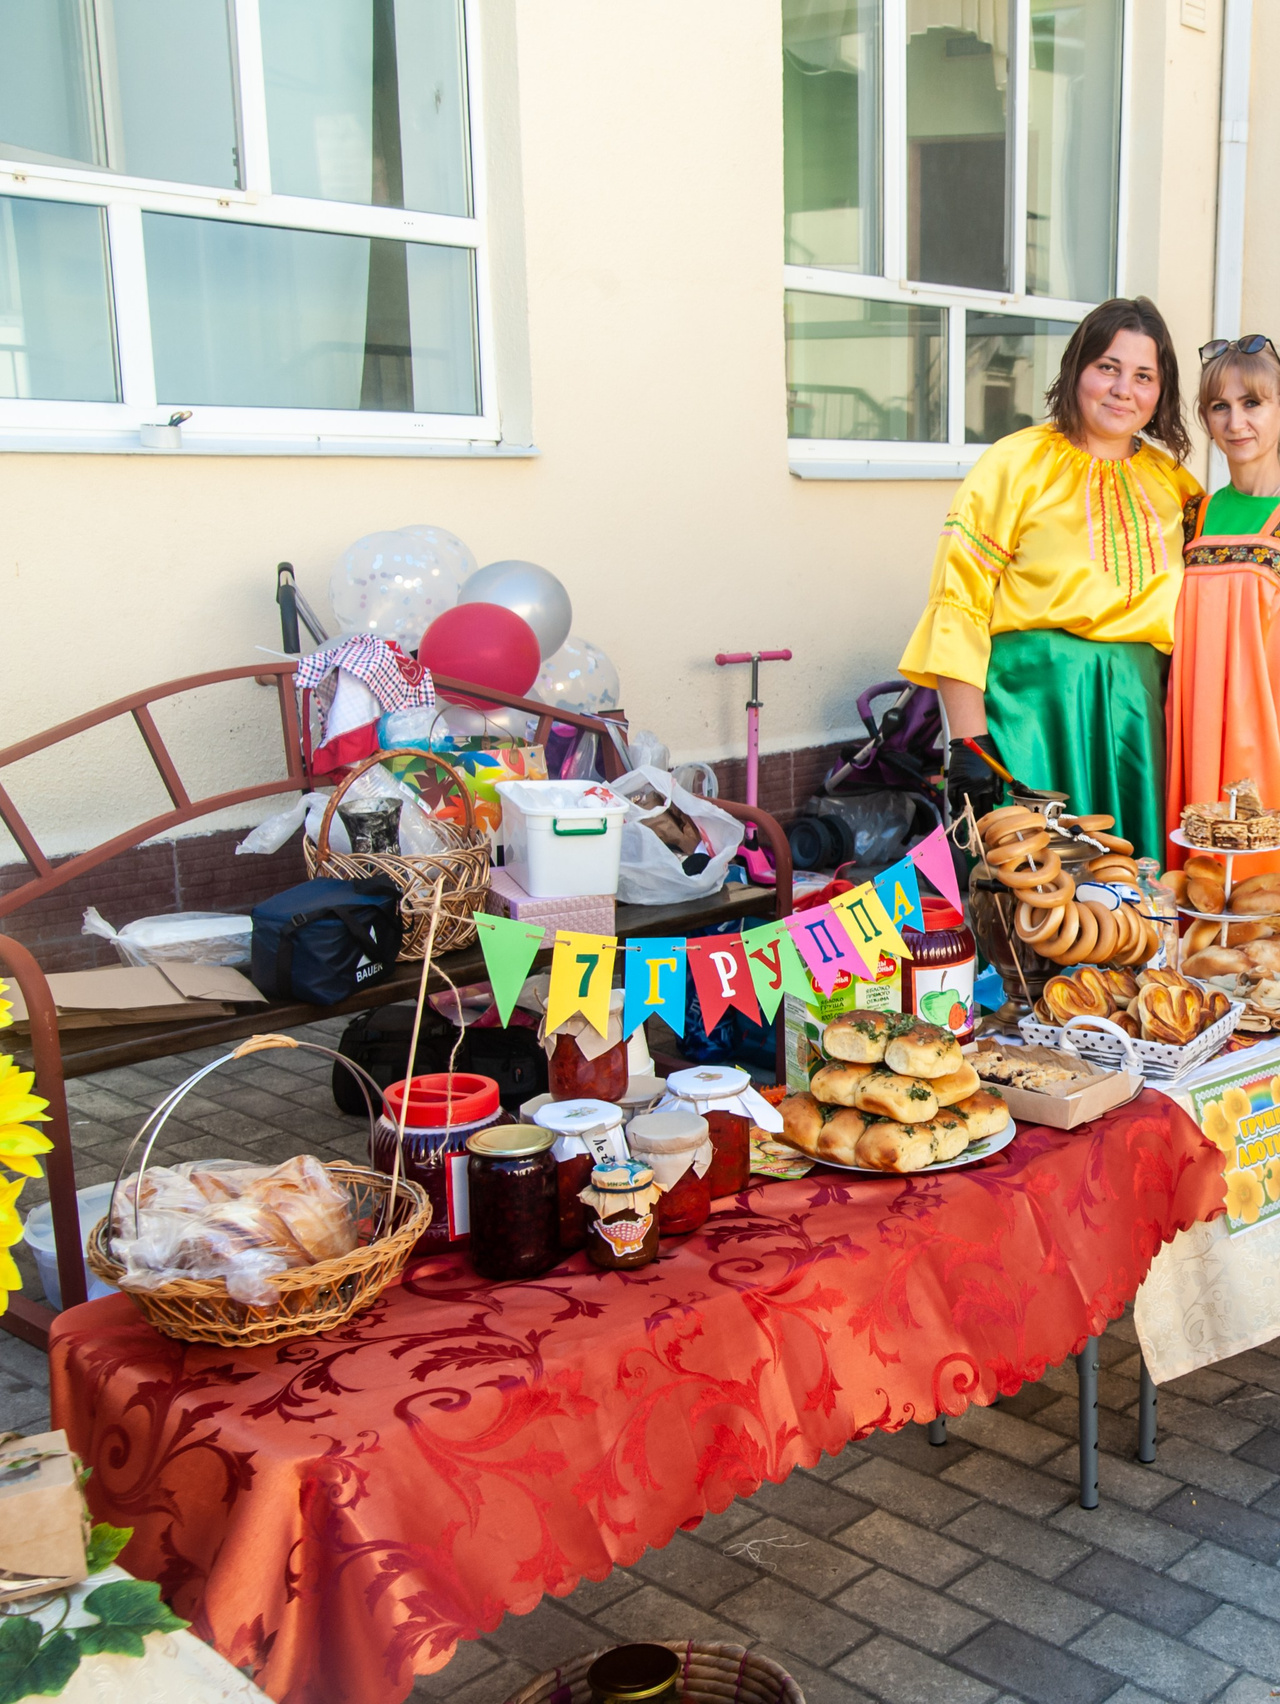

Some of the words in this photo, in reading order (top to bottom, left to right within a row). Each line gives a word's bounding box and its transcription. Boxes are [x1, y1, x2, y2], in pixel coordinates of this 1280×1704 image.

[356, 962, 384, 982] BAUER
[575, 953, 600, 998] 7
[644, 881, 915, 1005] ГРУППА
